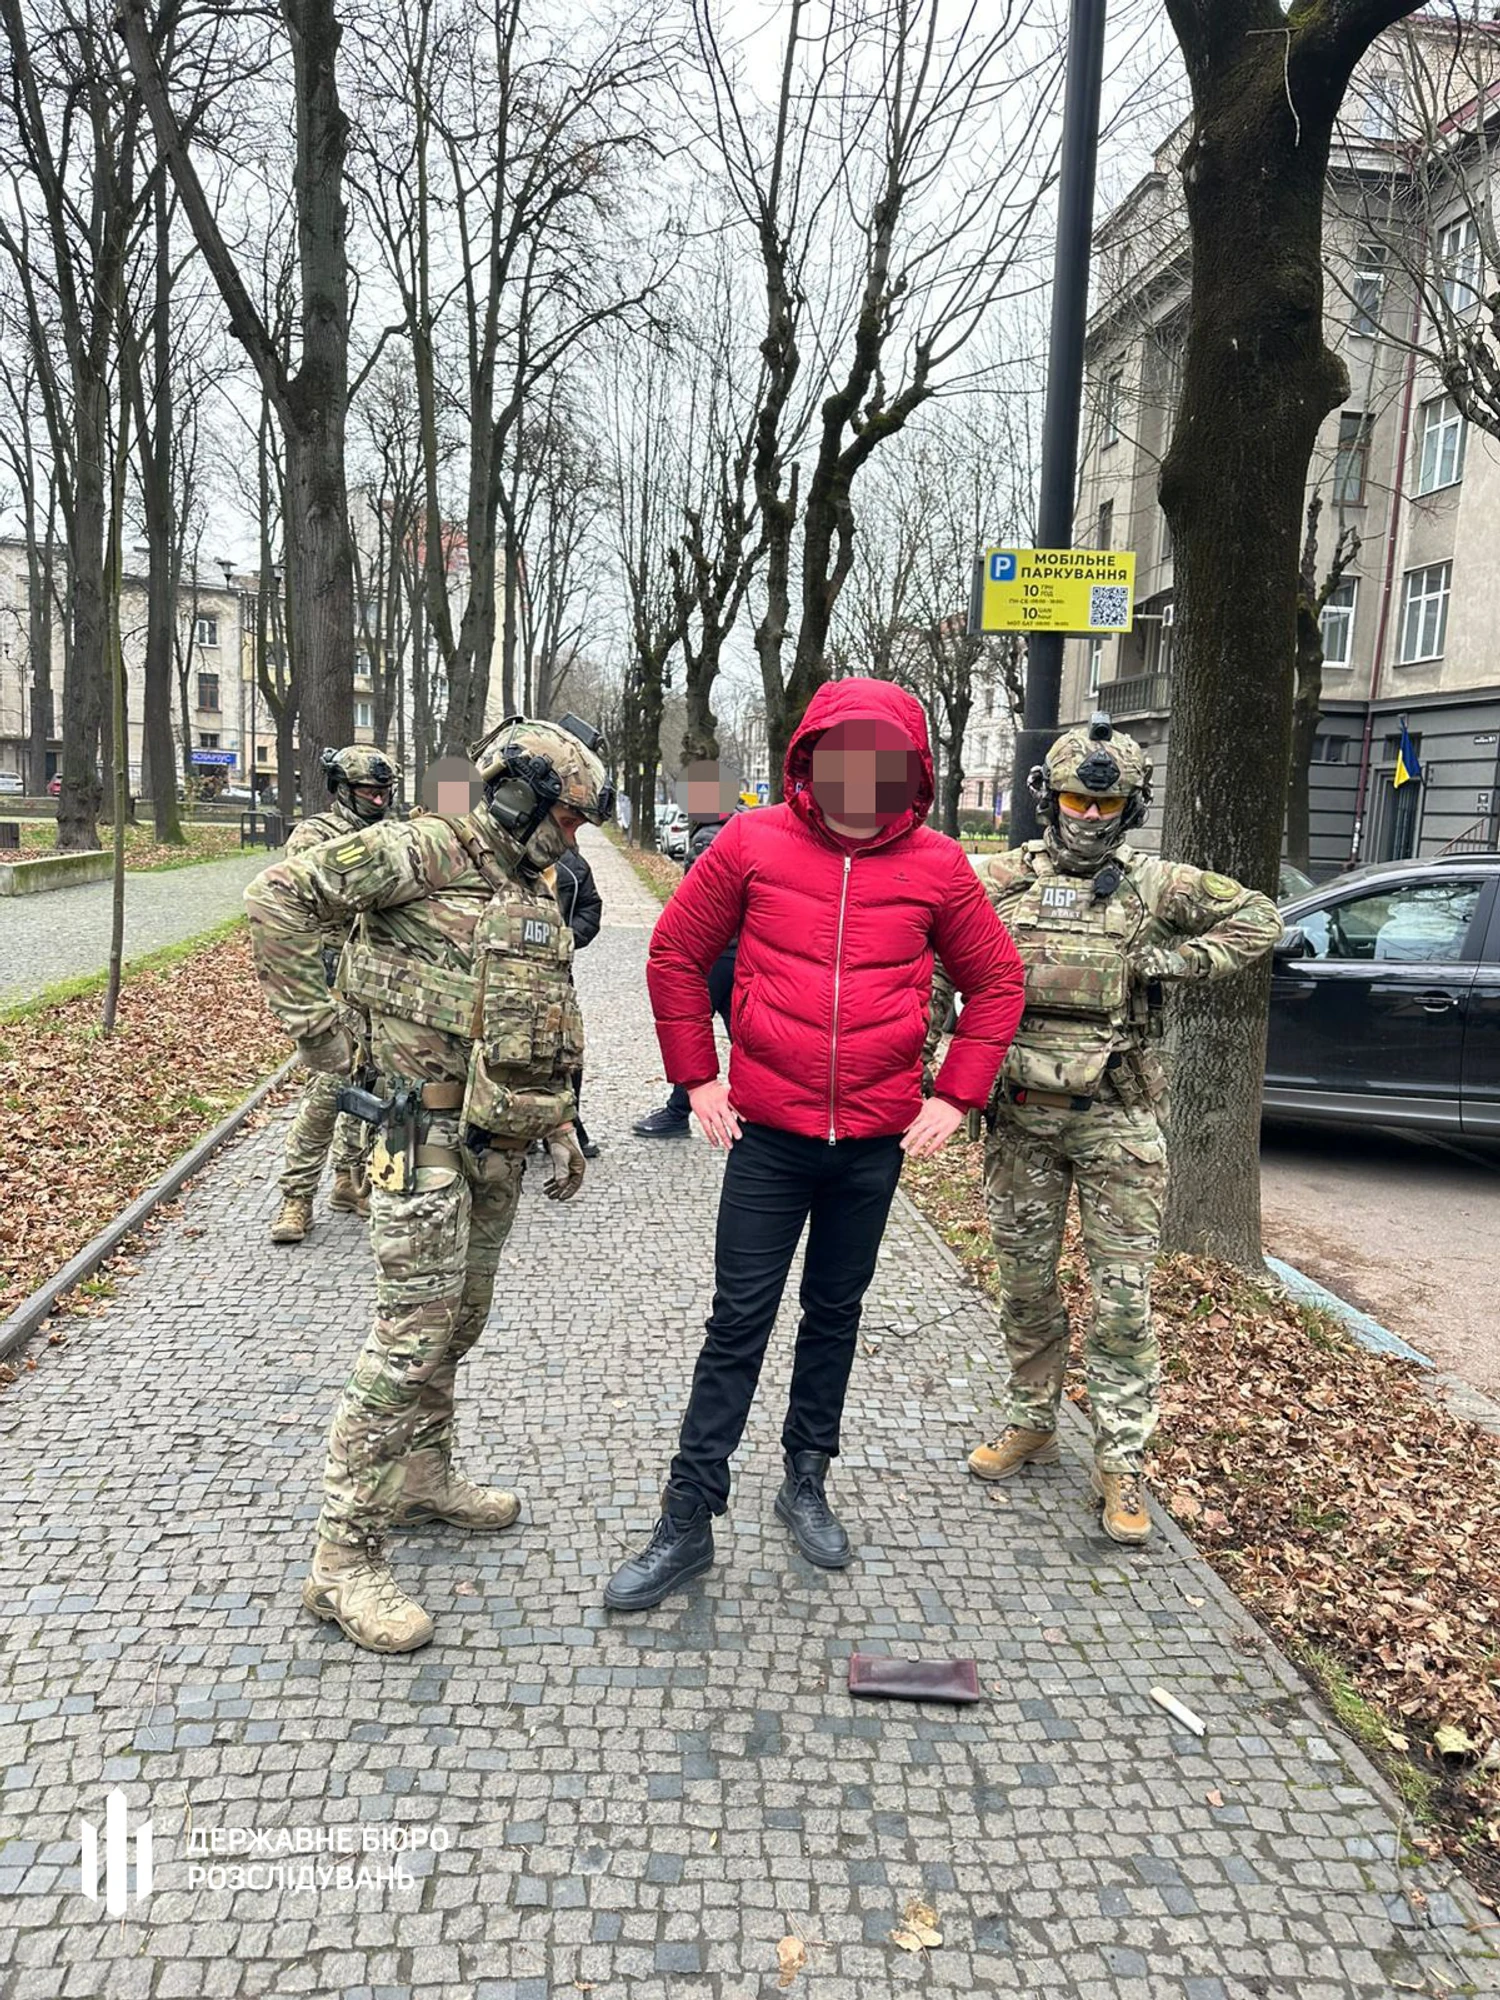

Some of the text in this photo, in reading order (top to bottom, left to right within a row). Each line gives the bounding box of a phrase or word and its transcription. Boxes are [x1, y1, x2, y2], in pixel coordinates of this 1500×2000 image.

[1034, 554, 1115, 566] МОБІЛЬНЕ
[1021, 567, 1127, 580] ПАРКУВАННЯ
[1023, 584, 1039, 597] 10
[1022, 607, 1038, 619] 10
[1041, 888, 1076, 907] ДБР
[524, 920, 550, 943] ДБР
